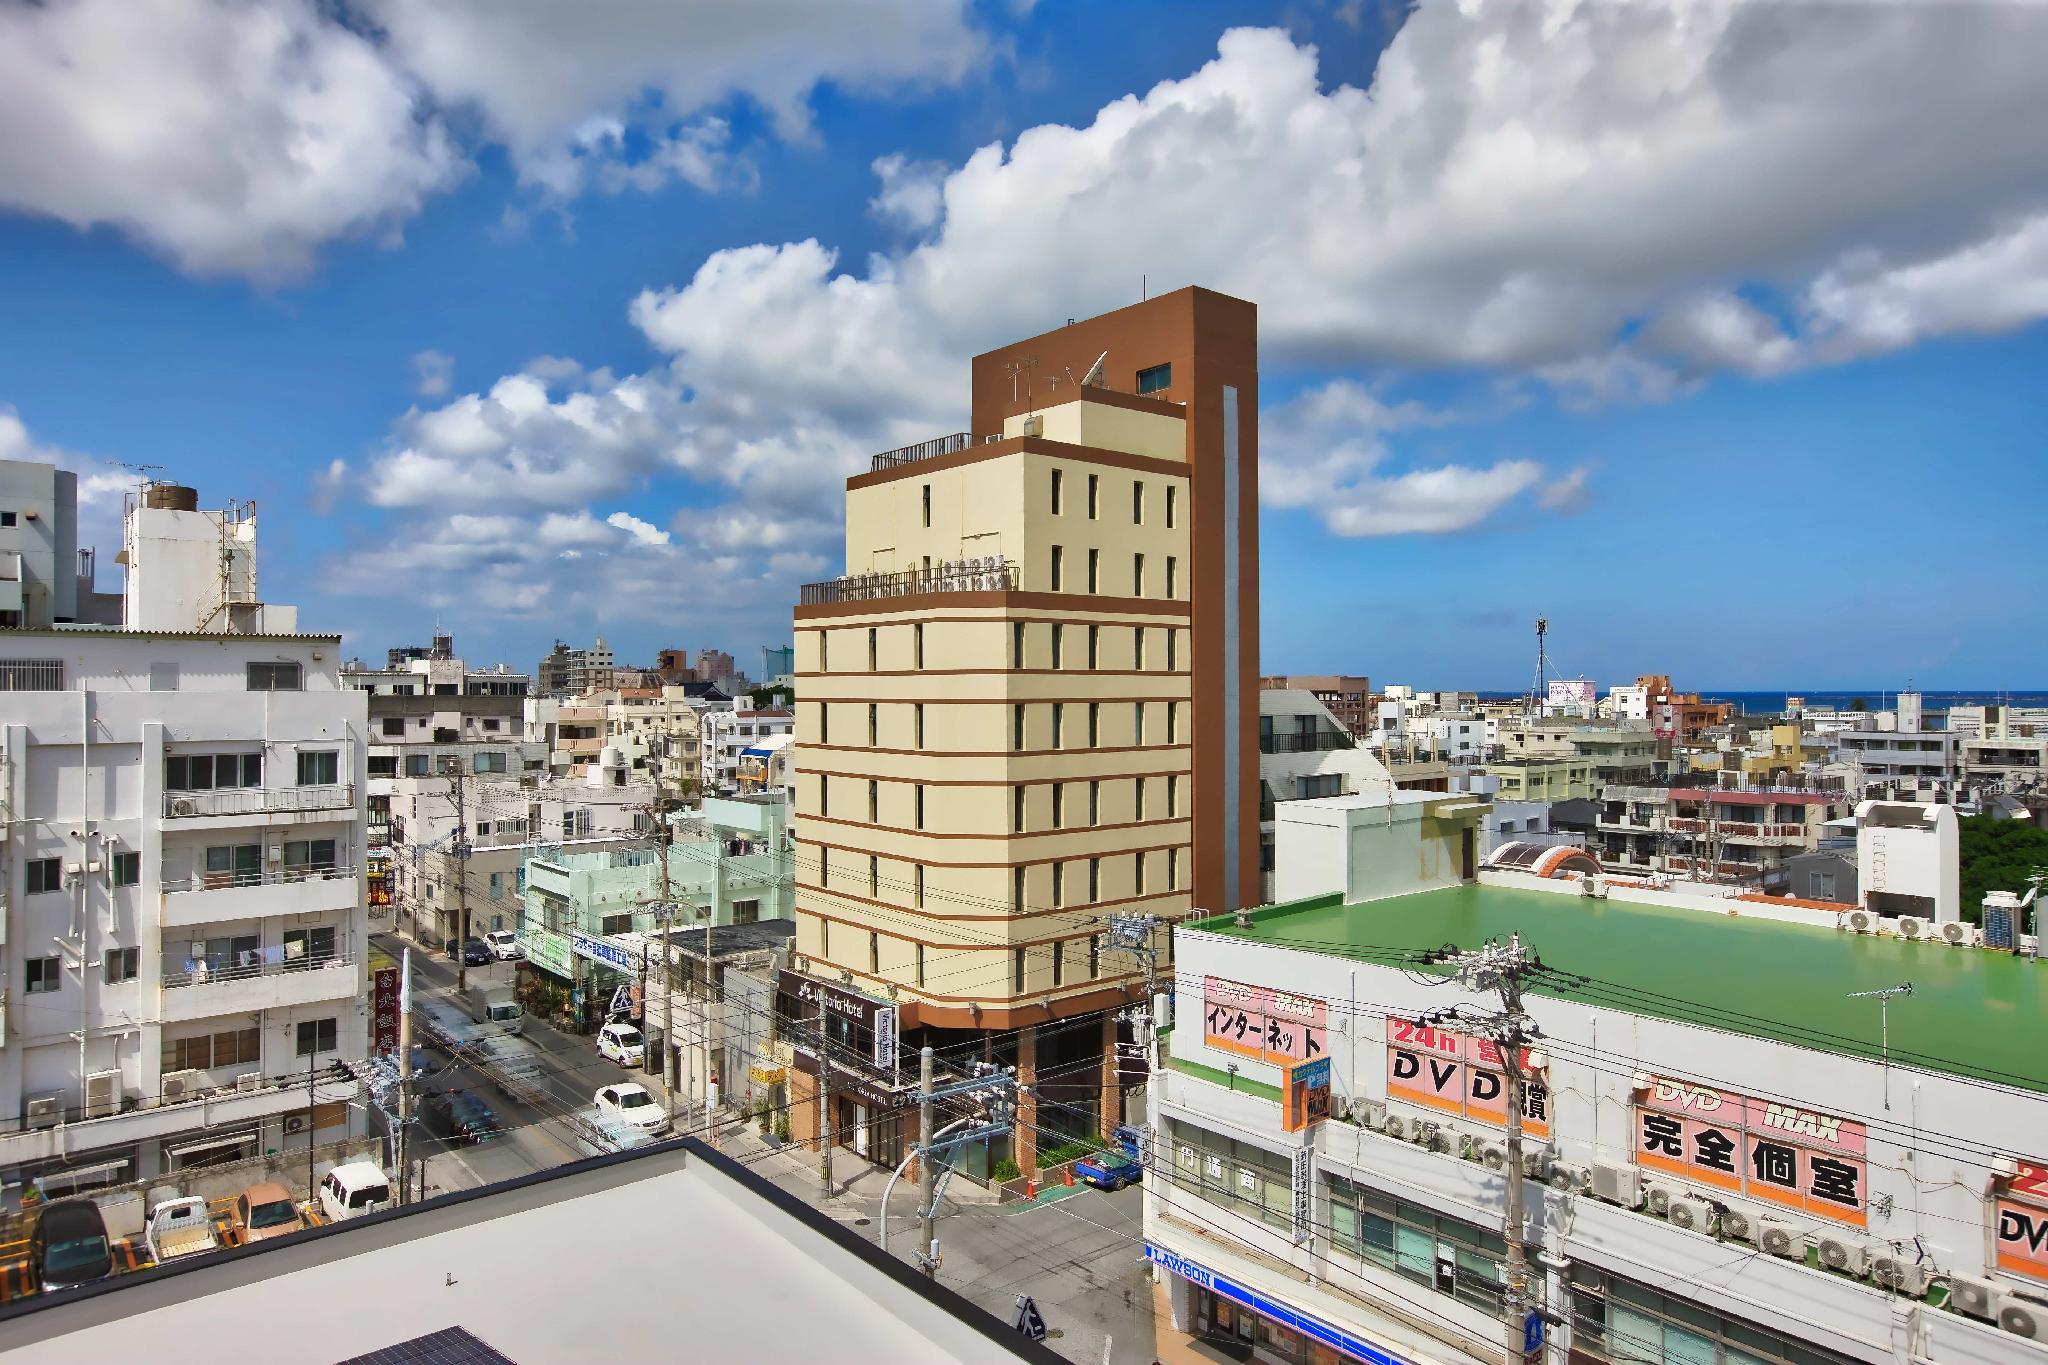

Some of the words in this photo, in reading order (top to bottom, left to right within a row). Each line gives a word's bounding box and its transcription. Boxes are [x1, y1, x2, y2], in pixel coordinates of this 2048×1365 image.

[814, 988, 842, 1012] Vtoria
[843, 998, 863, 1020] Hotel
[1207, 1005, 1321, 1059] インターネット
[1394, 1021, 1456, 1054] 24h
[1655, 1078, 1723, 1112] DVD
[1762, 1102, 1843, 1143] MAX
[1643, 1114, 1859, 1207] 完全個室
[1999, 1208, 2048, 1254] DV
[1154, 1249, 1211, 1287] LAWSON
